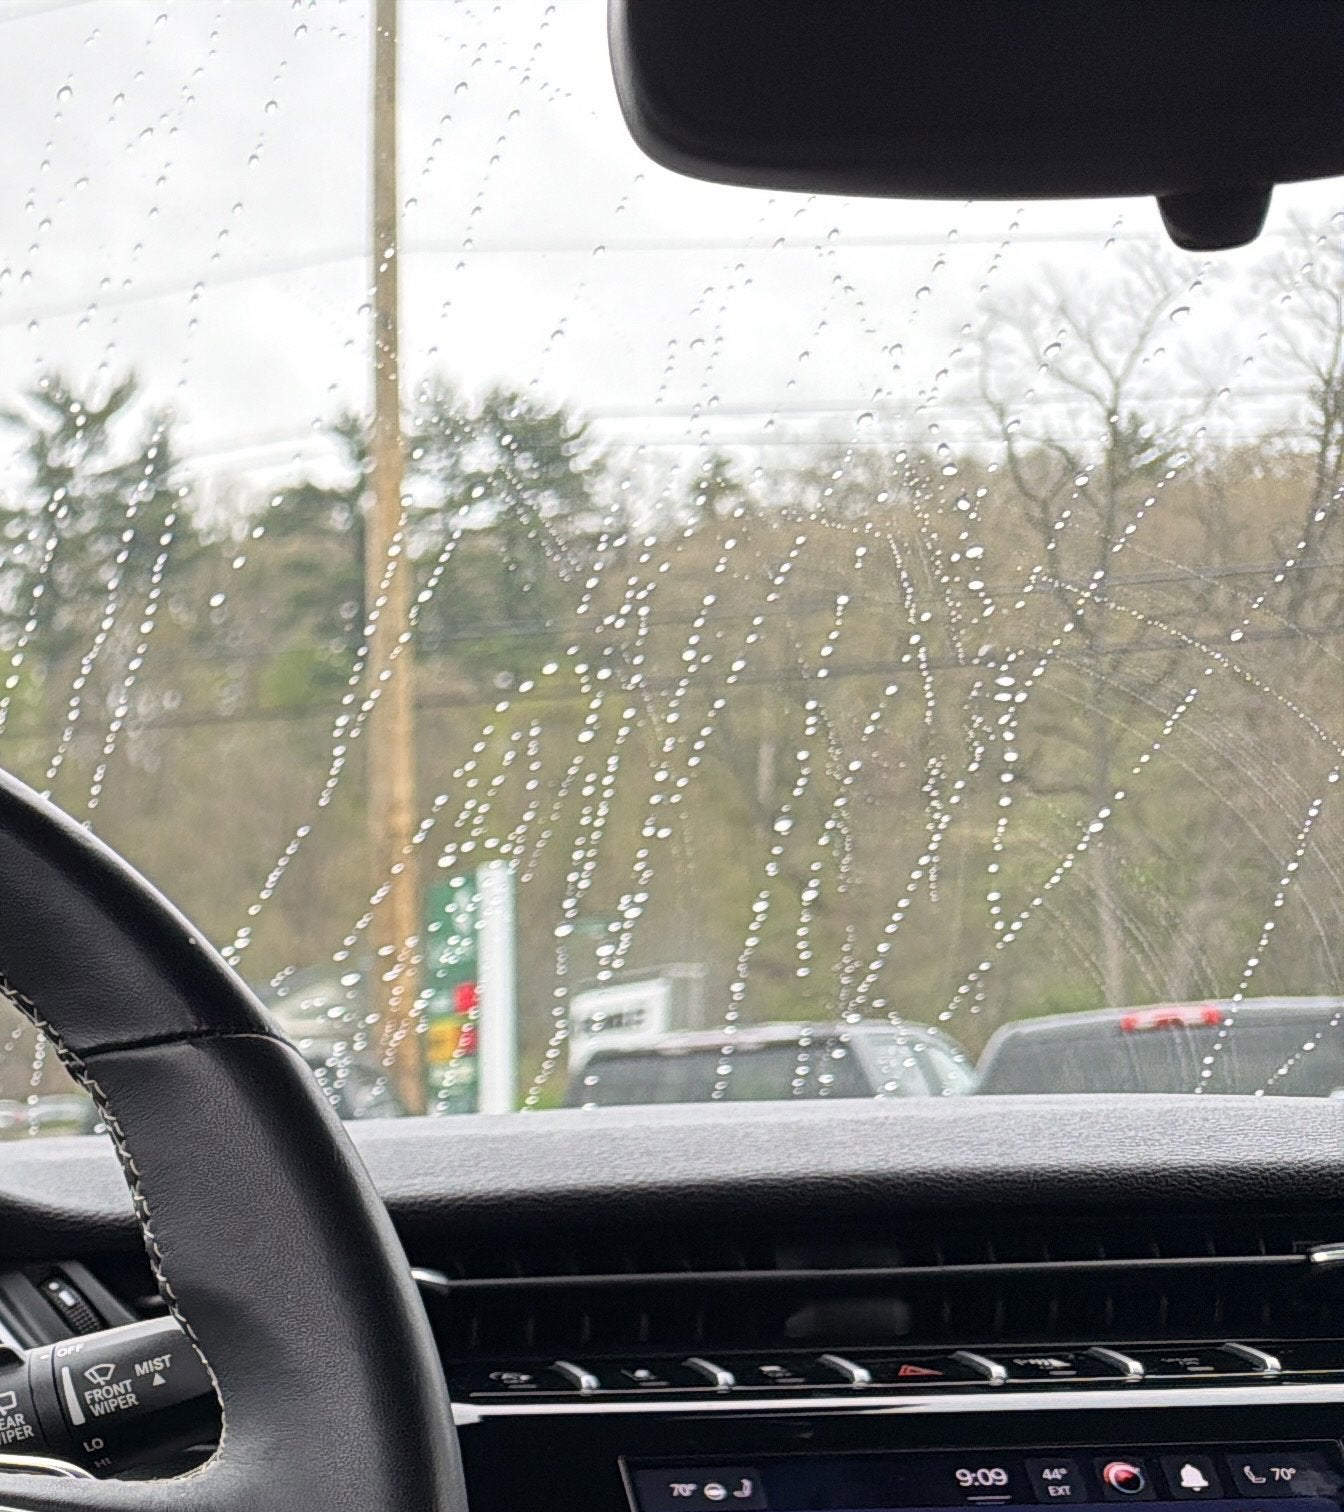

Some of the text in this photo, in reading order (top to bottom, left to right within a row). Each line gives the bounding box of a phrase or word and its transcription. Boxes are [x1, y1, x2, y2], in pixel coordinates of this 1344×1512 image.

[56, 1343, 85, 1358] OFF
[134, 1354, 172, 1377] MIST
[84, 1379, 133, 1403] FRONT
[88, 1394, 140, 1417] WIPER
[83, 1437, 104, 1453] LO
[955, 1467, 1009, 1487] 9:09
[1042, 1466, 1069, 1481] 44°
[1269, 1467, 1297, 1482] 70°
[1048, 1484, 1071, 1497] EXT
